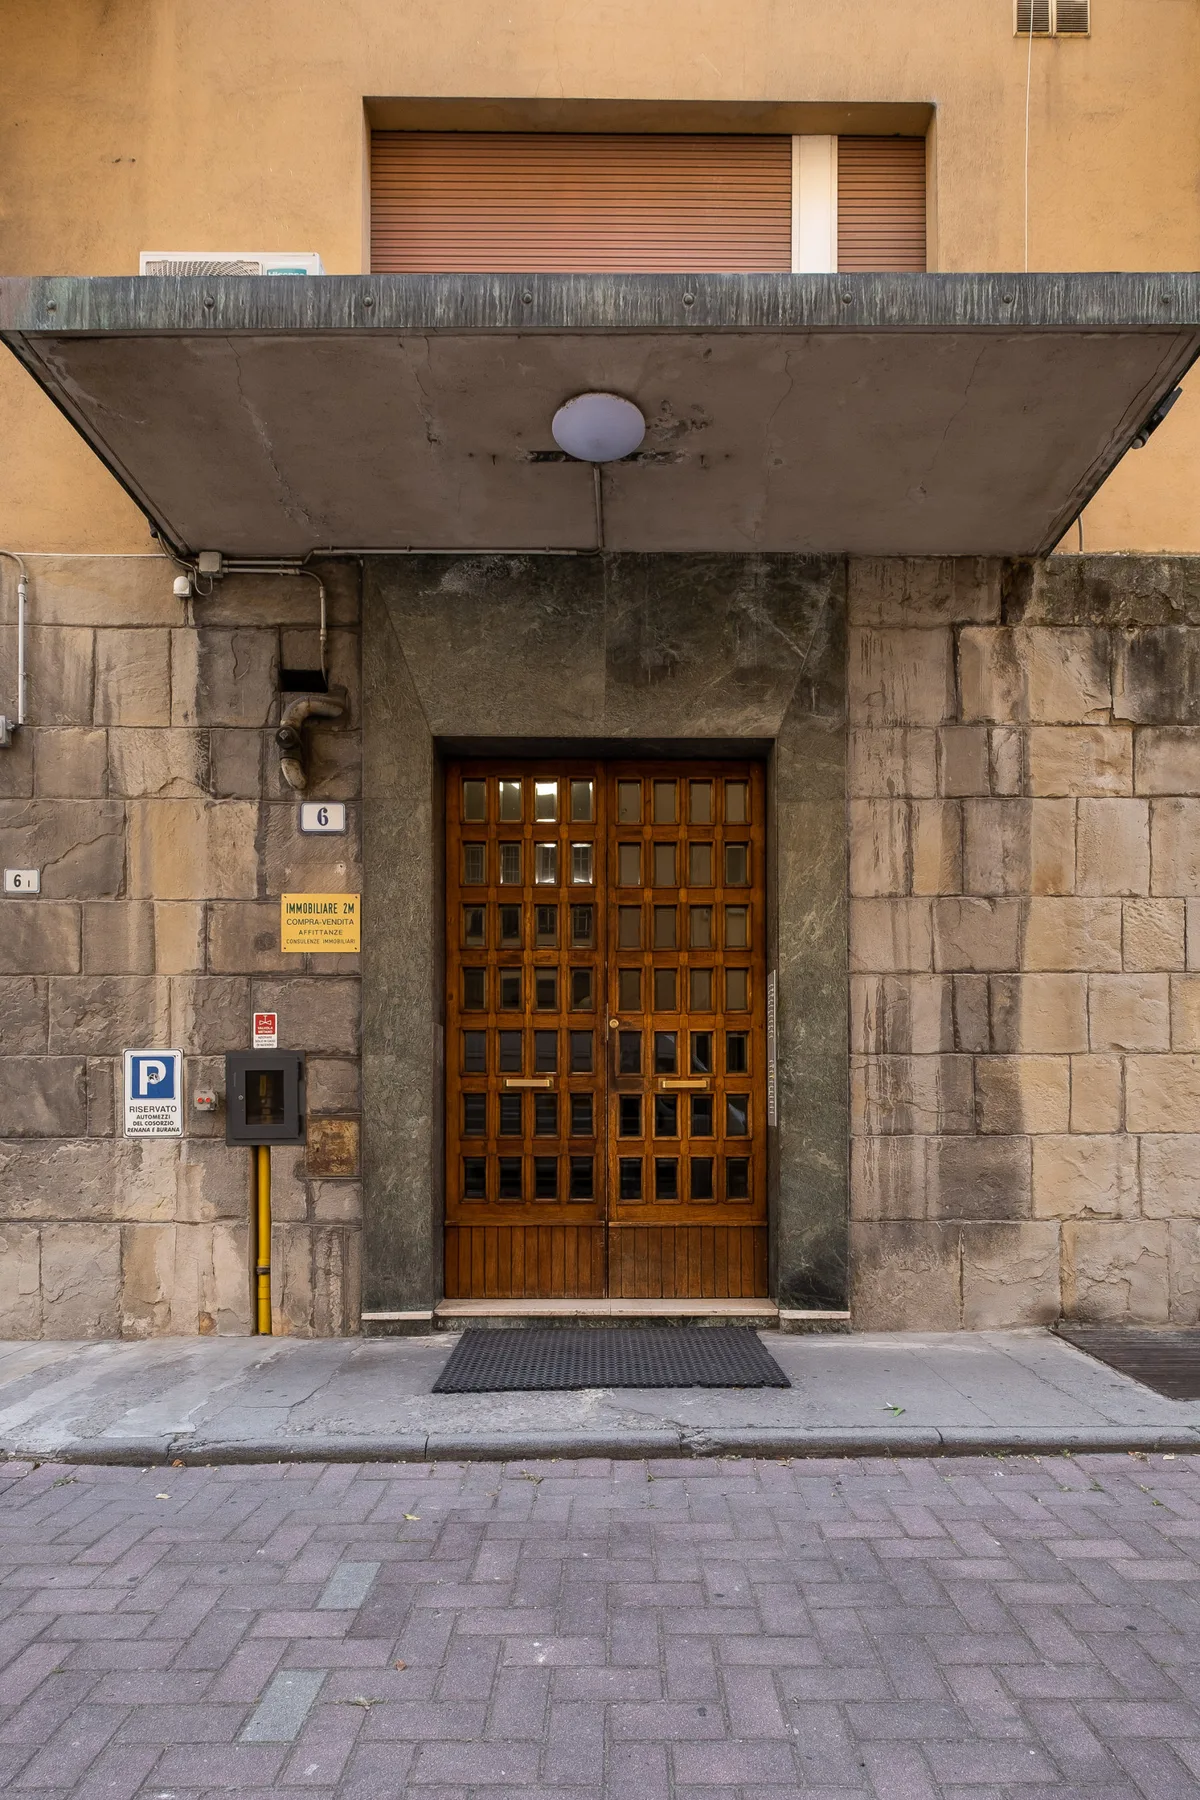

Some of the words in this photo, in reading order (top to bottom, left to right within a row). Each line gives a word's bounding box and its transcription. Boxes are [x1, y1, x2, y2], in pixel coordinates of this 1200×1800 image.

[317, 807, 328, 826] 6
[13, 874, 22, 888] 6
[286, 902, 338, 914] IMMOBILIARE
[343, 902, 355, 914] 2M
[286, 918, 355, 926] COMPRA-VENDITA
[139, 1060, 167, 1095] P
[129, 1105, 177, 1113] RISERVATO
